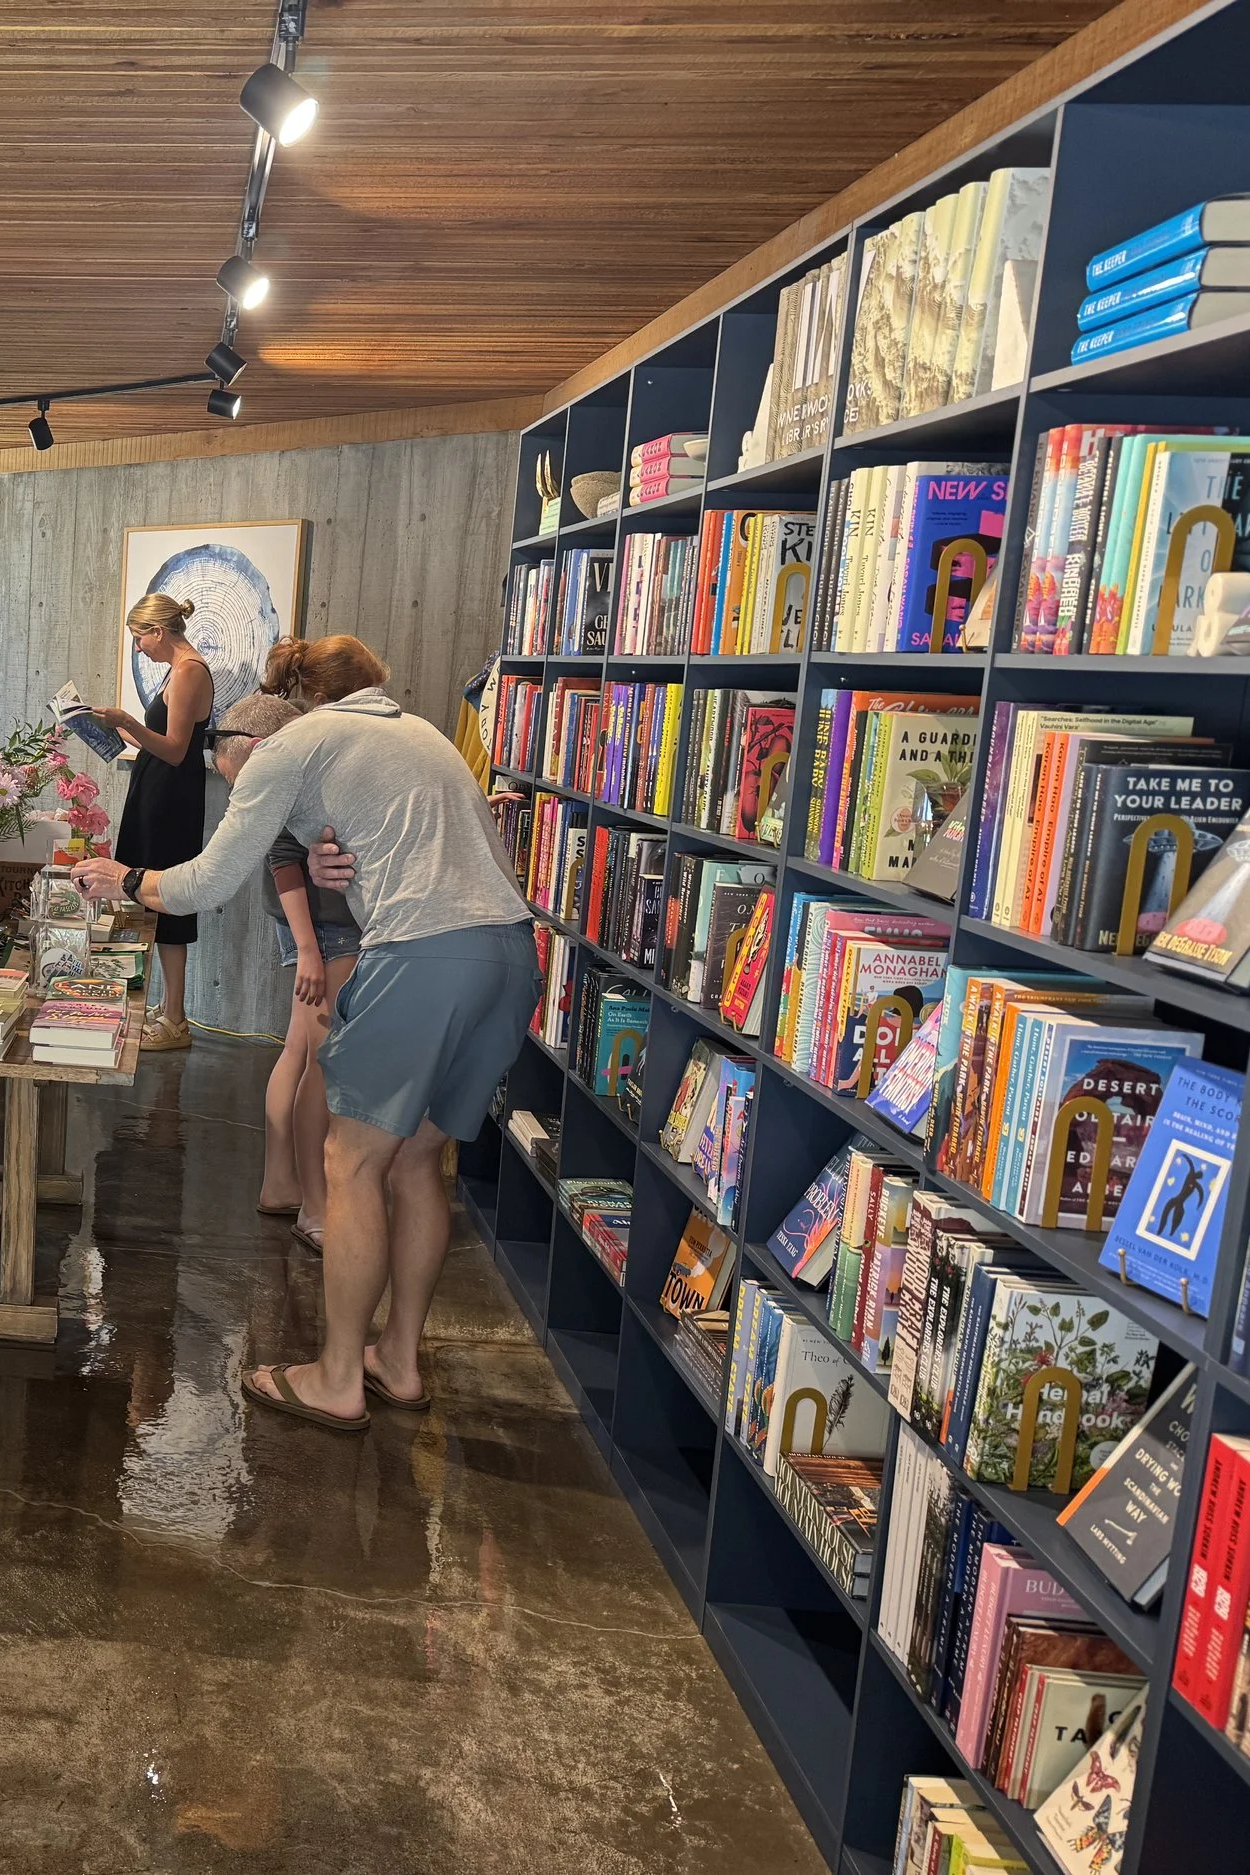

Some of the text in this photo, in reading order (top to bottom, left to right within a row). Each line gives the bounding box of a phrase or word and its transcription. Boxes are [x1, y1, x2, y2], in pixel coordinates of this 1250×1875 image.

[1092, 250, 1127, 277] THE KEEPER
[1084, 292, 1122, 316] THE KEEPER
[1077, 331, 1114, 353] THE KEEPER
[928, 481, 987, 500] NEW
[1097, 451, 1114, 542] CELESTIAL LIGHTS
[849, 509, 861, 538] KIN
[865, 508, 876, 536] KIN
[709, 695, 718, 741] HEARTWOOD
[869, 697, 884, 711] The
[1121, 718, 1139, 726] Digital
[899, 749, 928, 762] AND
[919, 732, 976, 744] GUARDI
[1127, 777, 1234, 792] TAKE ME TO
[1029, 742, 1052, 866] Karen Hao Empire
[1041, 742, 1066, 868] Karen Hao Empire
[1114, 795, 1242, 811] YOUR LEADER
[860, 964, 948, 978] MONAGHAN
[873, 953, 942, 967] ANNABEL
[949, 993, 978, 1153] WALK THE PARK FEDARKO
[974, 1000, 1001, 1162] WALK THE PARK FEDARKO
[1005, 1053, 1020, 1116] Gather, Parent
[1020, 1058, 1036, 1121] Gather, Parent
[1034, 1037, 1051, 1123] DESERT SOLITAIRE
[1083, 1078, 1161, 1095] DESERT
[1178, 1077, 1230, 1101] THE BODY
[1186, 1096, 1204, 1111] THE
[1184, 1124, 1213, 1143] HEALING
[804, 1184, 838, 1221] PROBLEM
[867, 1190, 876, 1220] SALLY
[866, 1188, 890, 1330] BUCKEYE PATRICK RYAN
[664, 1271, 705, 1310] TOWN
[918, 1276, 938, 1380] THE EXPLORERS CLUB
[930, 1285, 951, 1390] THE EXPLORERS CLUB
[727, 1284, 746, 1413] DREAM STATE
[742, 1294, 761, 1424] DREAM STATE
[802, 1350, 830, 1363] Theo
[1135, 1448, 1169, 1482] DRYING
[1209, 1459, 1223, 1497] ANDREW
[1124, 1477, 1169, 1525] SCANDINAVIAN
[1125, 1500, 1148, 1523] WAY
[1205, 1499, 1216, 1523] ROSS
[1233, 1478, 1247, 1519] ANDREW
[1090, 1524, 1126, 1564] LARS MYTTING
[1200, 1524, 1213, 1561] SORKIN
[1229, 1521, 1241, 1546] ROSS
[1190, 1564, 1208, 1598] 1929
[1223, 1547, 1236, 1583] SORKIN
[938, 1532, 959, 1654] MODERN FRAME
[952, 1543, 974, 1668] MODERN FRAME
[1214, 1585, 1232, 1621] 1929
[957, 1555, 979, 1680] MODERN FRAME
